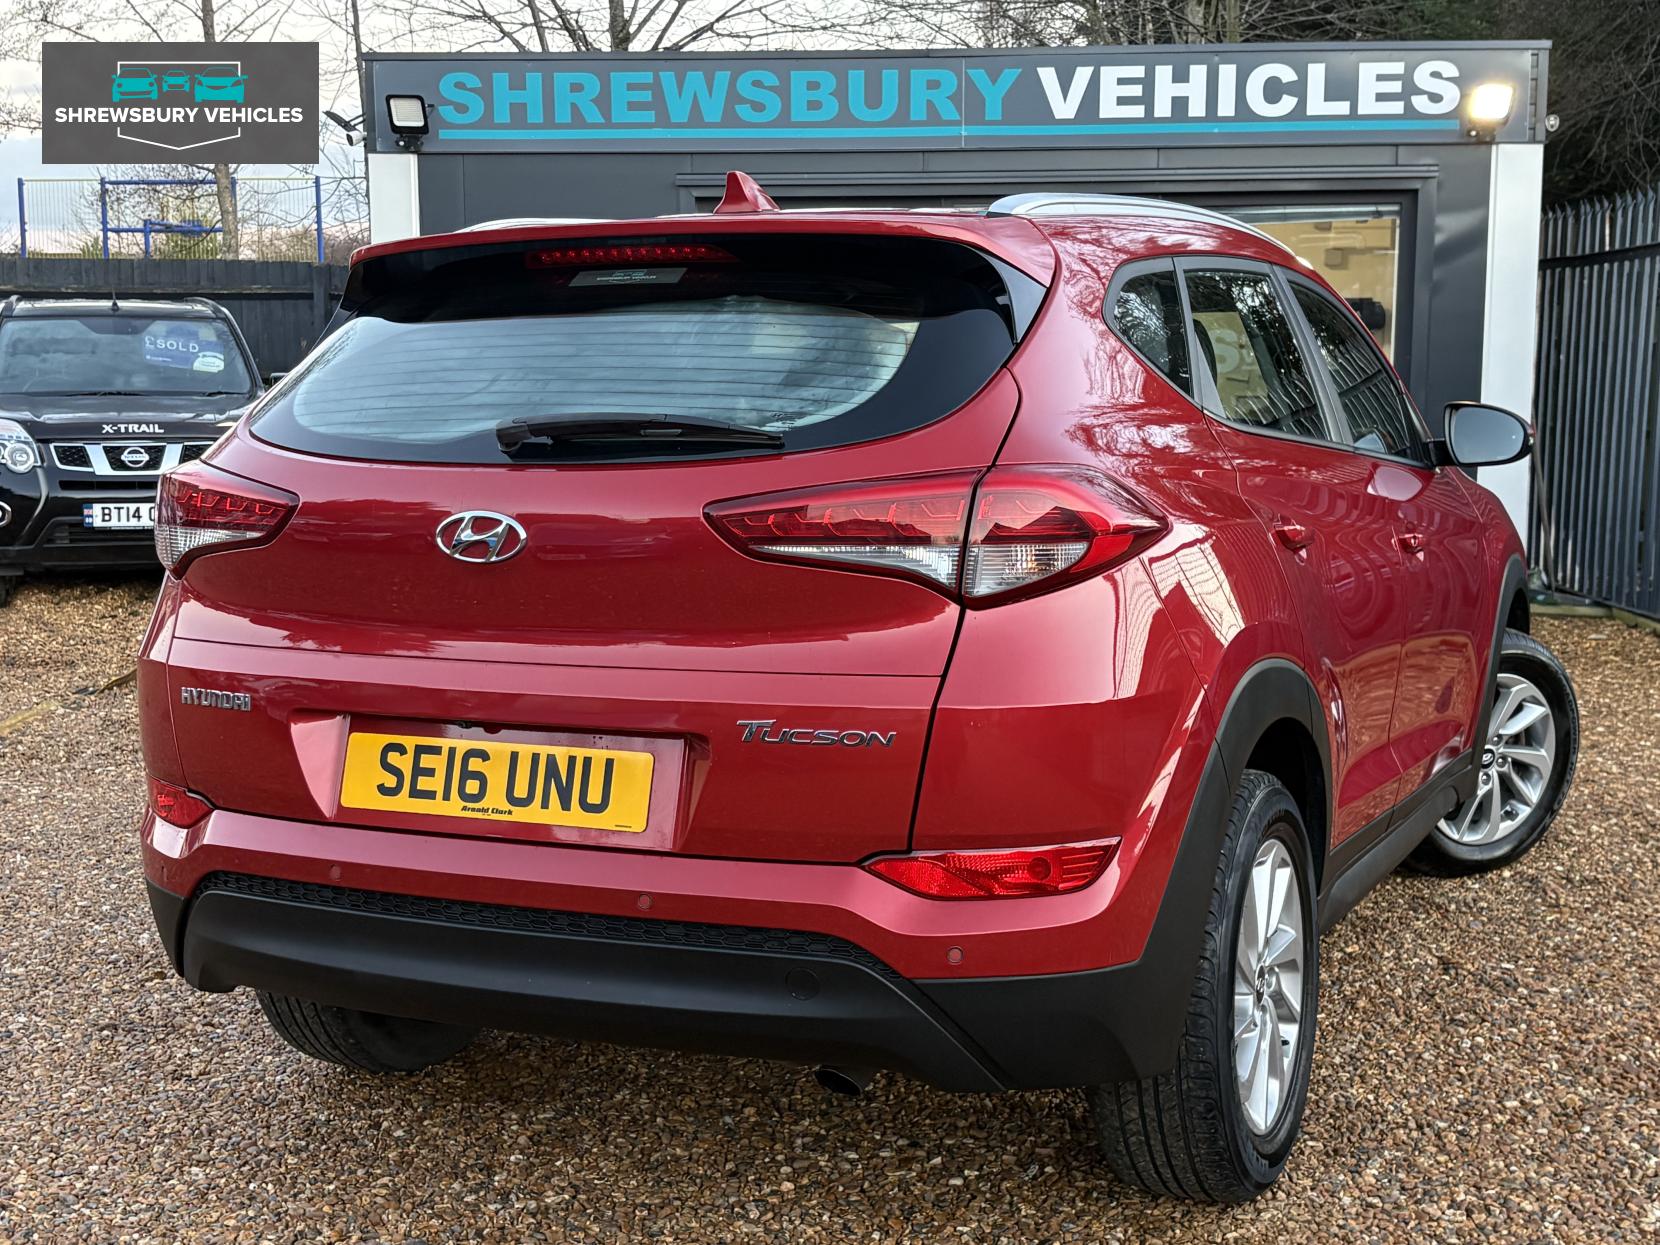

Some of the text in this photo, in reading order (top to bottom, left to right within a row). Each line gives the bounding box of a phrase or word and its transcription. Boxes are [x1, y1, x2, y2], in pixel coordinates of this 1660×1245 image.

[438, 60, 1461, 125] SHREWSBURY VEHICLES
[102, 423, 165, 434] X-TRAIL
[101, 506, 143, 523] BT14
[181, 686, 251, 711] HYUNDAI
[376, 742, 615, 815] SE16 UNU
[461, 805, 490, 814] Arnold
[490, 807, 513, 816] Clark
